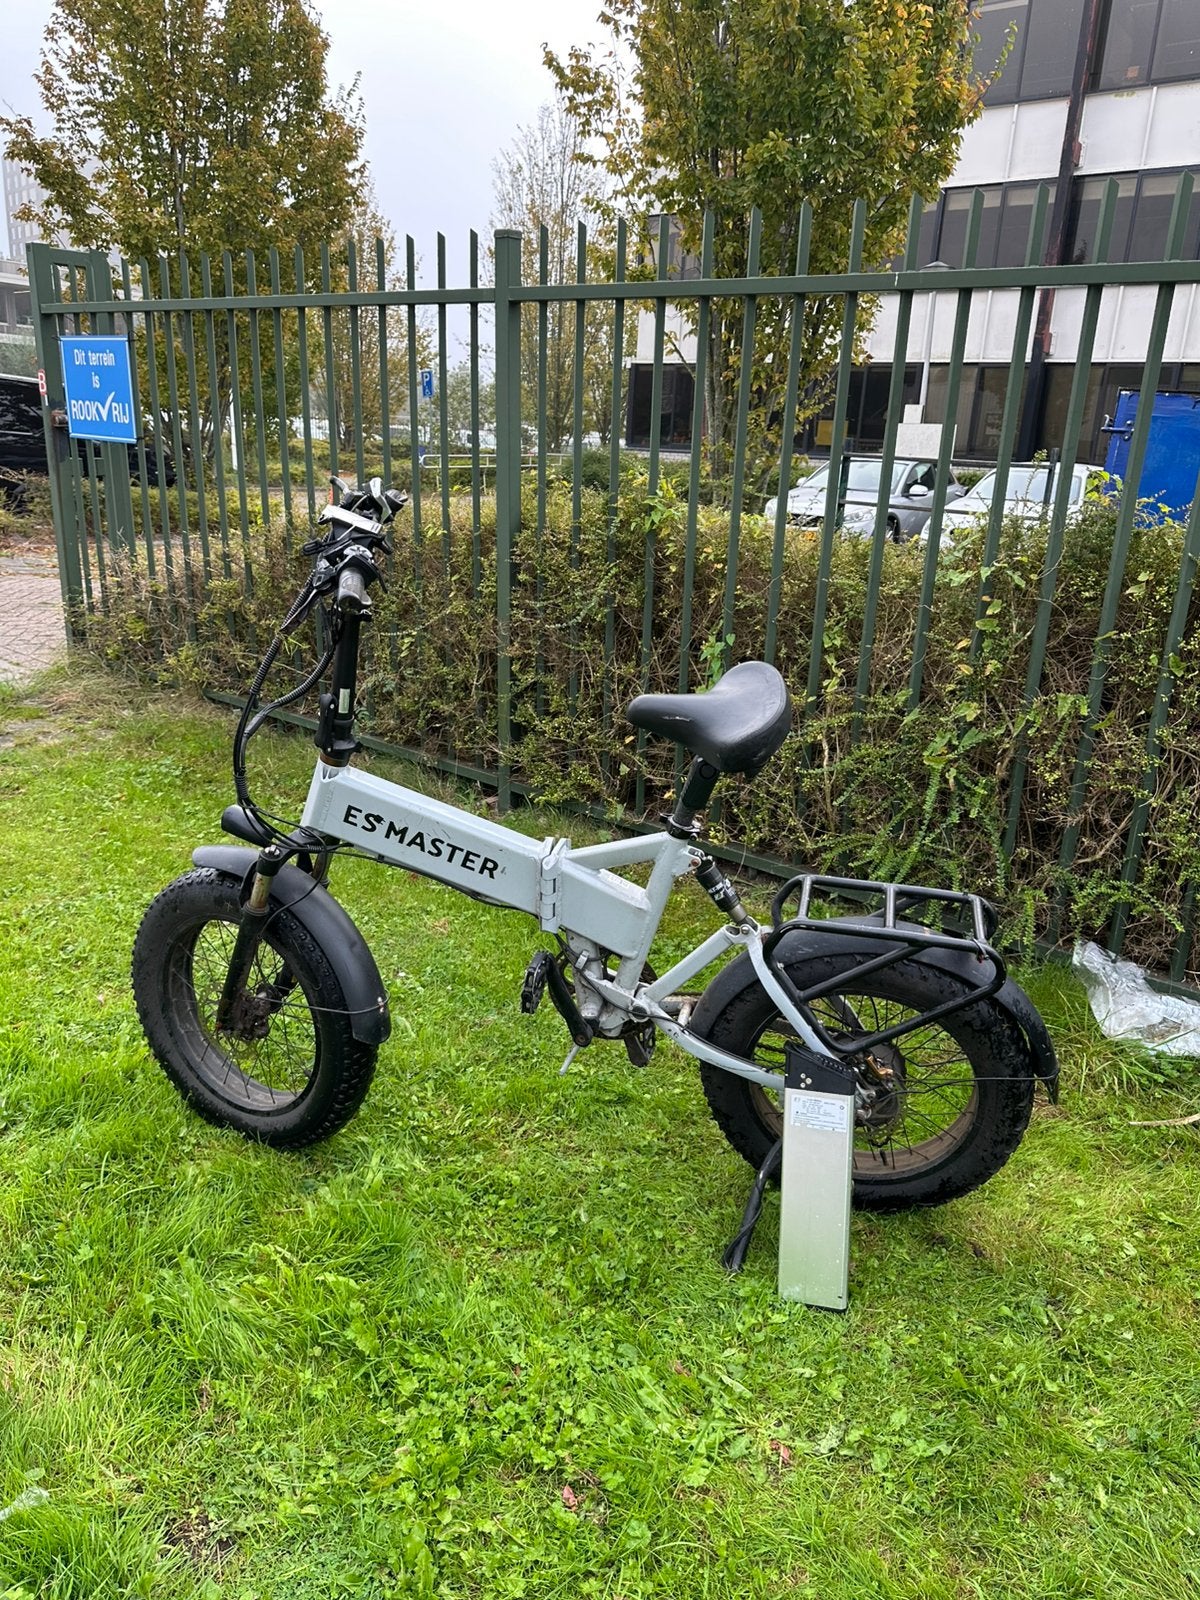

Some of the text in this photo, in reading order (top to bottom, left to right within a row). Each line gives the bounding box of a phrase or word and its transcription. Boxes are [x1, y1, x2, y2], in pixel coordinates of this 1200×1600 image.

[74, 348, 115, 366] Dit terrein
[91, 371, 100, 388] is
[423, 372, 430, 386] P
